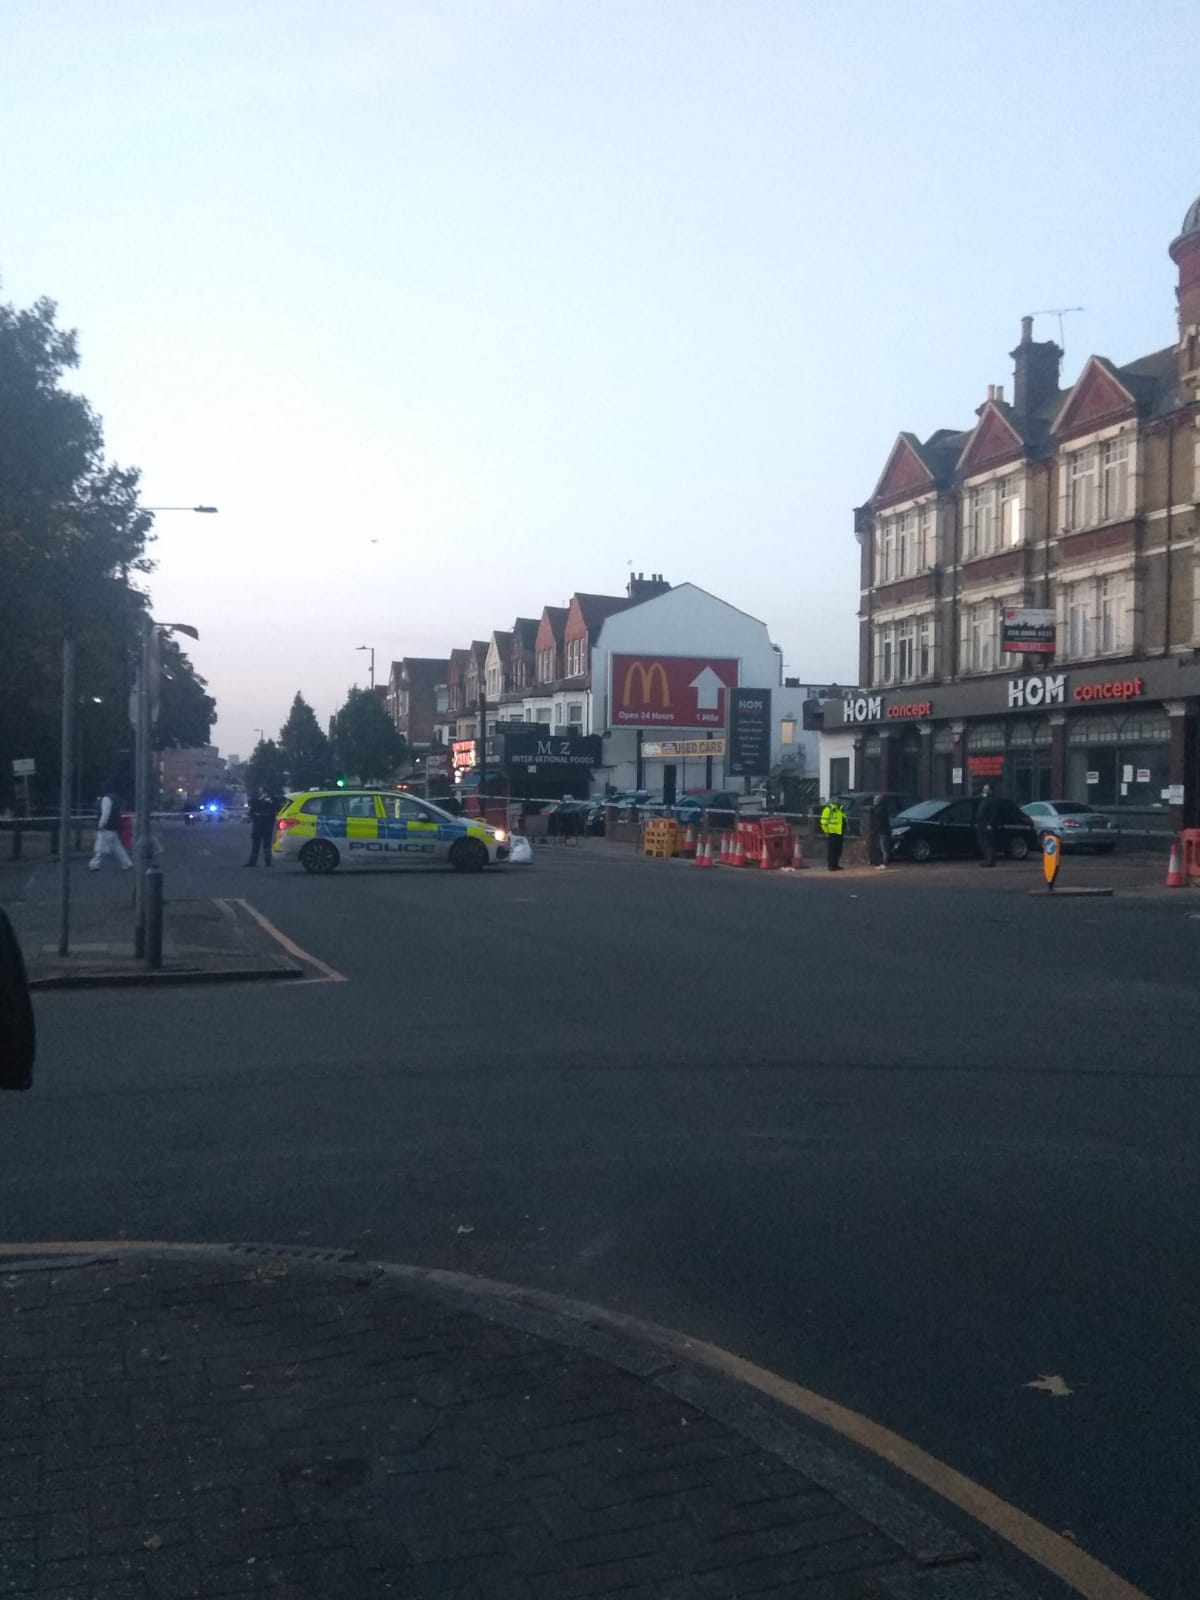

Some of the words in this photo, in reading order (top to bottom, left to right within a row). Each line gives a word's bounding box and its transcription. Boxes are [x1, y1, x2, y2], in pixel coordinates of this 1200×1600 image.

[1008, 674, 1067, 707] HOM
[1072, 677, 1142, 700] concept
[843, 696, 882, 722] HOM
[887, 701, 931, 718] concept
[619, 711, 639, 720] Open
[640, 711, 650, 719] 24
[652, 711, 674, 720] Hours
[702, 713, 719, 721] Mile
[537, 740, 552, 755] M
[560, 742, 571, 755] Z
[699, 741, 722, 753] CARS
[570, 756, 594, 764] FOODS
[349, 841, 435, 853] POLICE
